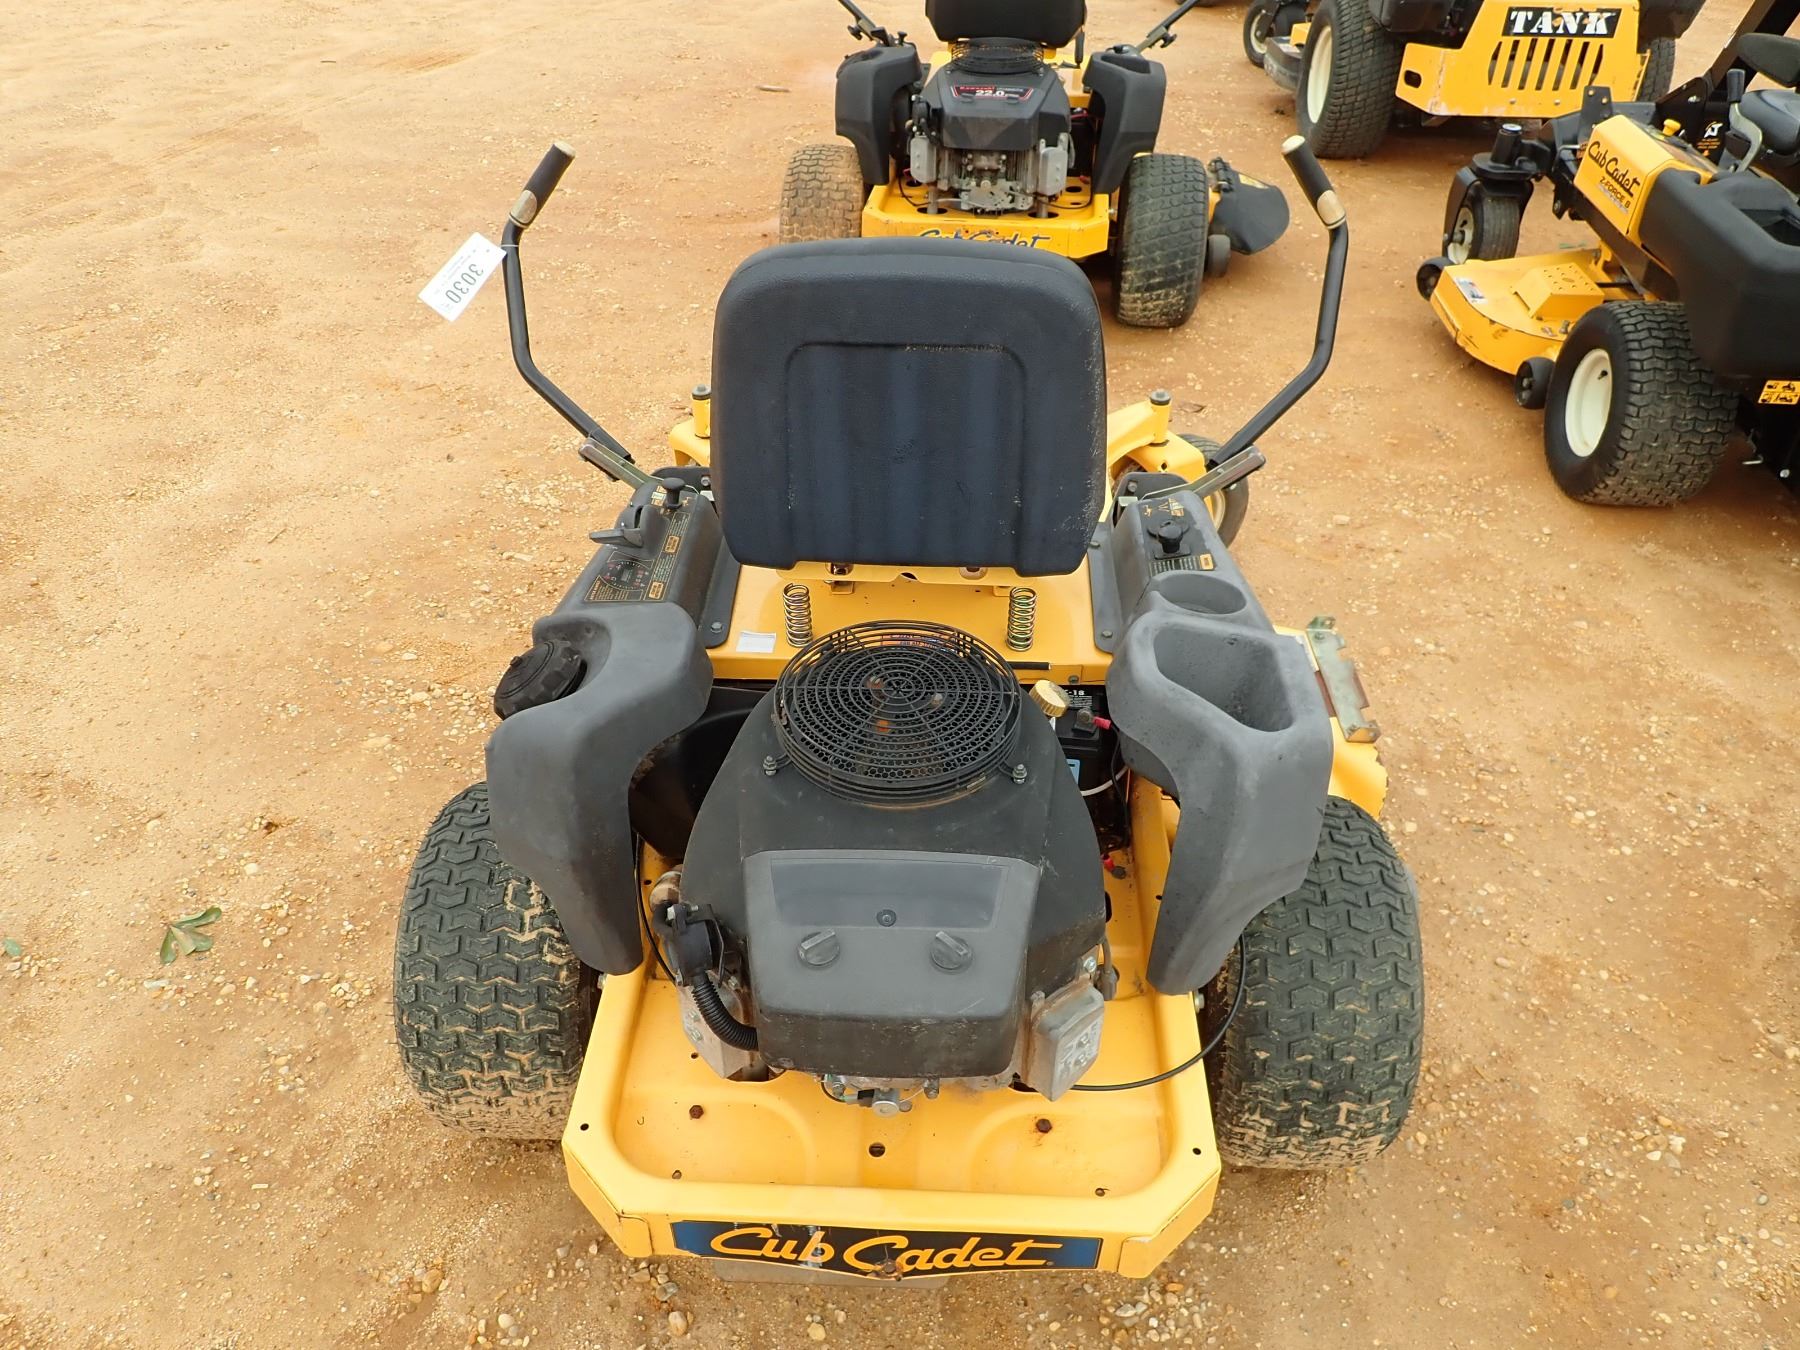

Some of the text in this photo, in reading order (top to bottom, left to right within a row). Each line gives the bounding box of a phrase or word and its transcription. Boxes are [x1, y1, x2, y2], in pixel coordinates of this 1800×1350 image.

[1510, 10, 1616, 35] TANK
[1588, 141, 1640, 198] Cub Cadet
[445, 263, 484, 304] 3030
[711, 1226, 1063, 1273] Cub Cadet
